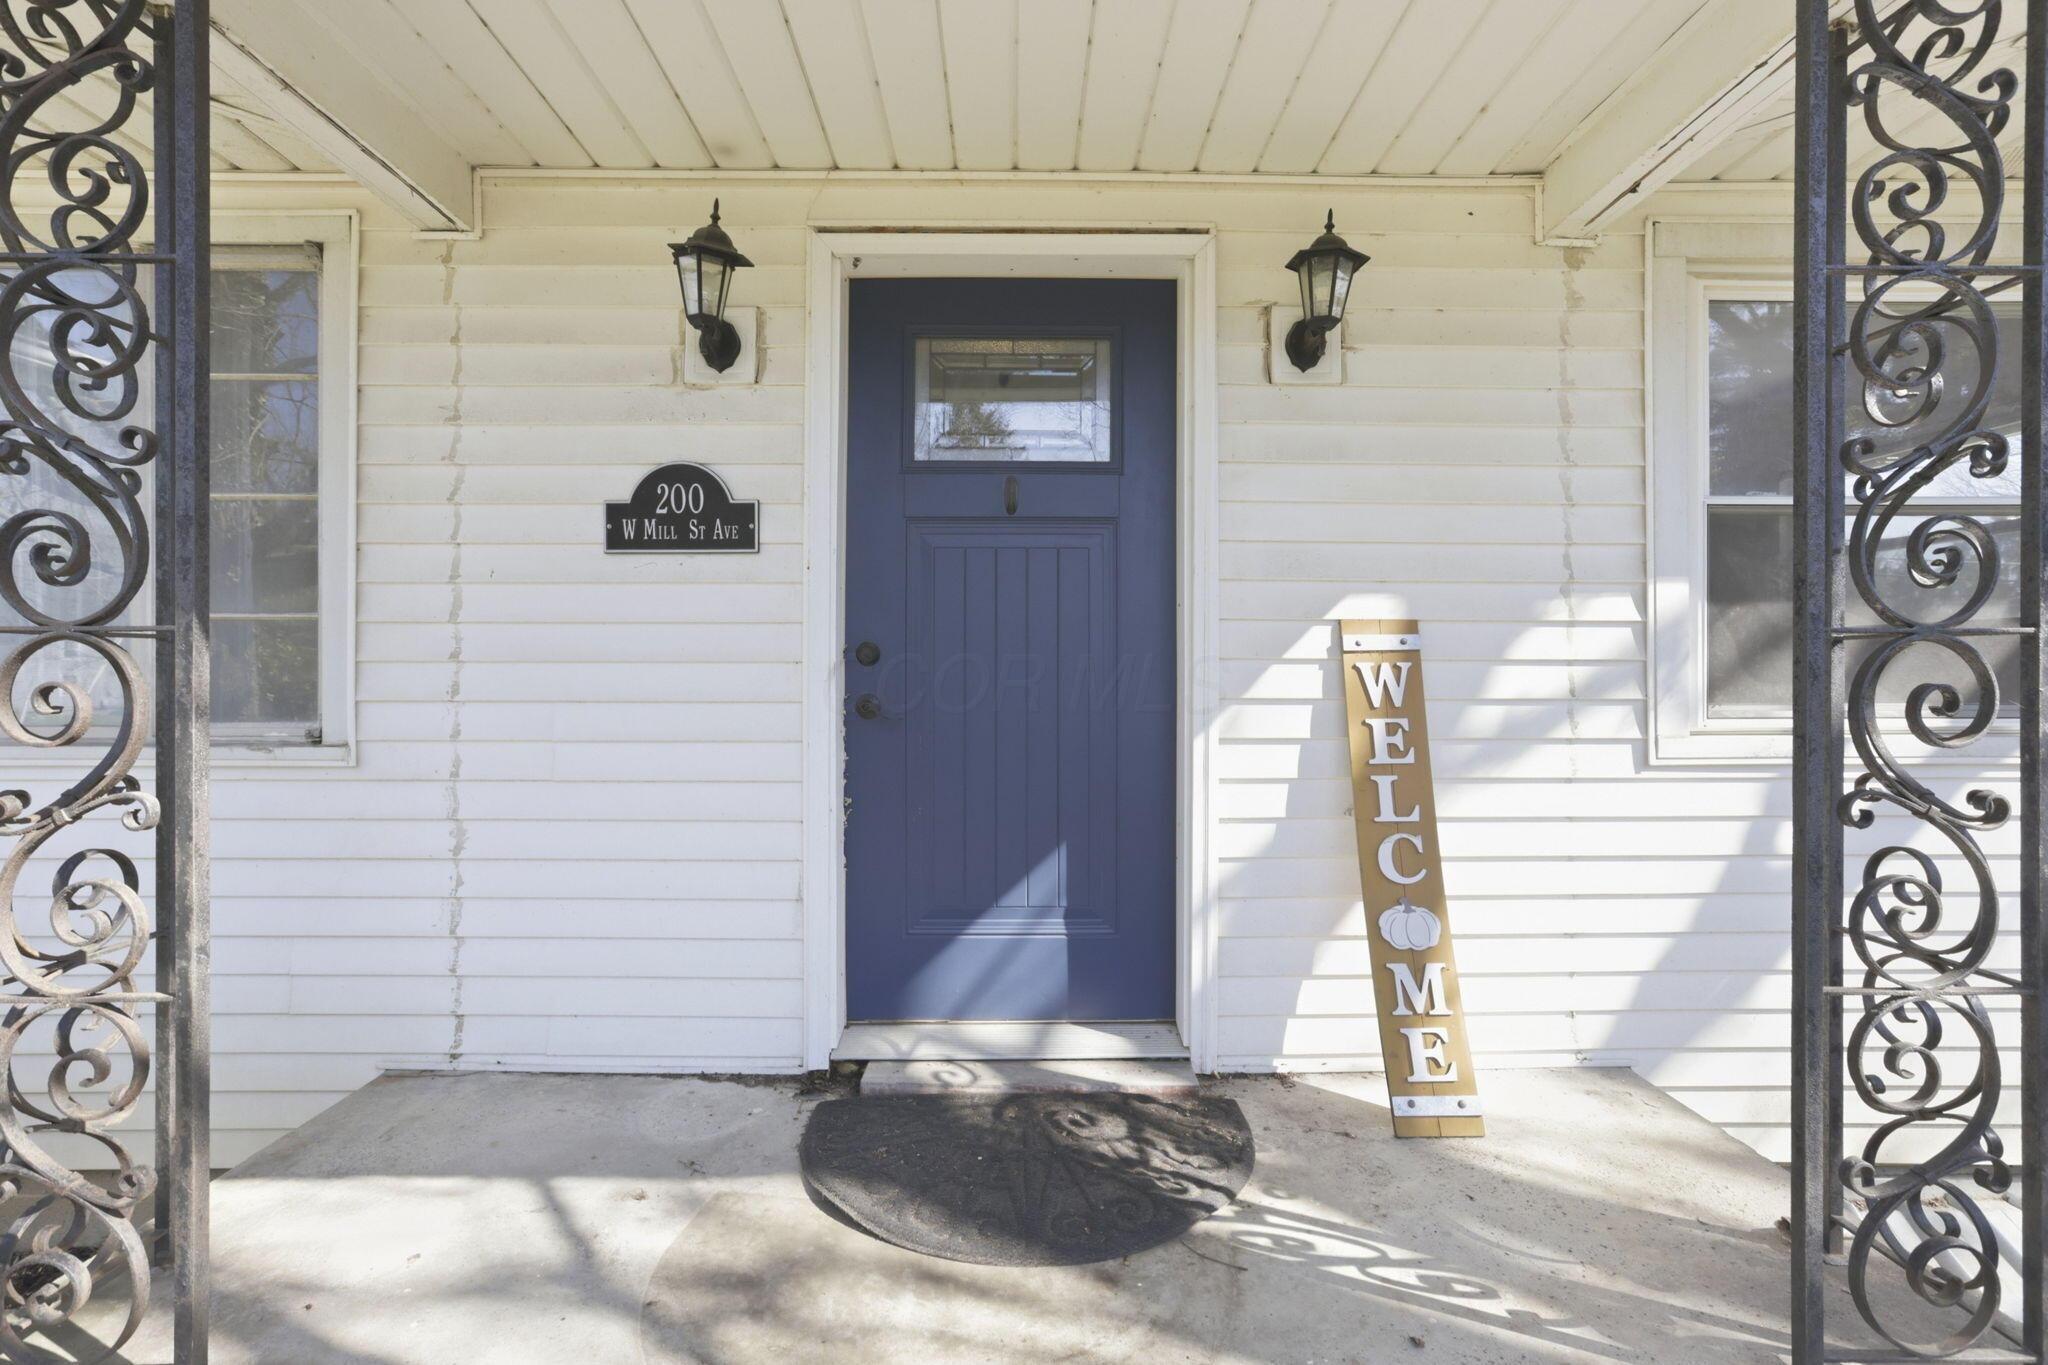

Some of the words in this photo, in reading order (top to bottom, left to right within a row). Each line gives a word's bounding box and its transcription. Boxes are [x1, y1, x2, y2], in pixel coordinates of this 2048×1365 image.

[656, 483, 704, 514] 200
[622, 519, 637, 540] W
[1353, 661, 1457, 1083] WELCME
